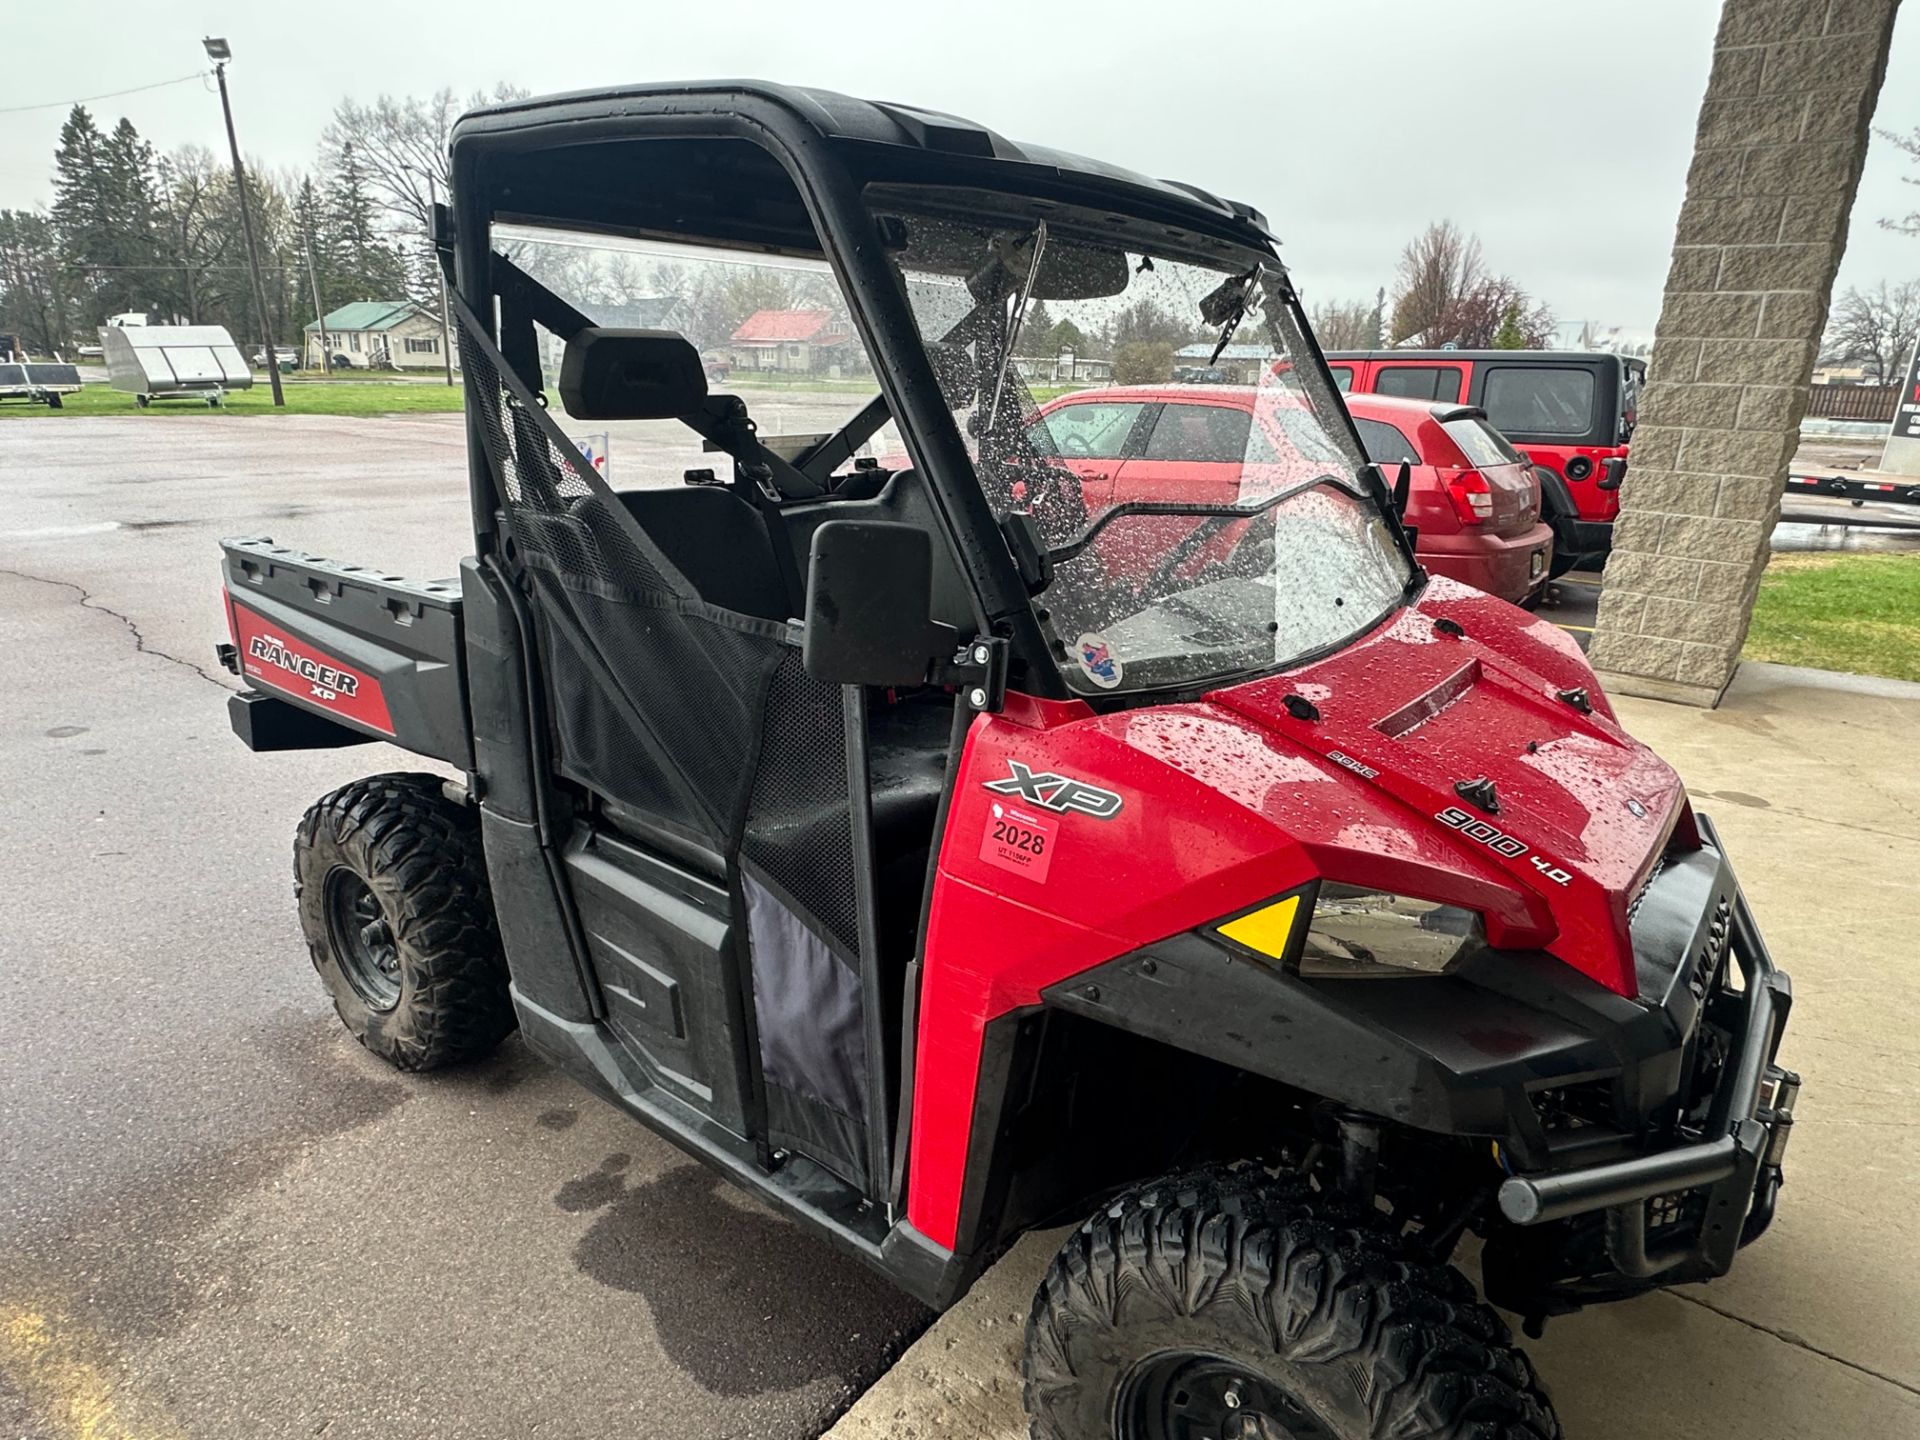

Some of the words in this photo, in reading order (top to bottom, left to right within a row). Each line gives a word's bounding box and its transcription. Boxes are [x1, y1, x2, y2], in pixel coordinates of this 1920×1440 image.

[249, 635, 358, 697] RANGER
[310, 684, 336, 700] XP
[982, 759, 1123, 818] XP
[992, 821, 1045, 855] 2028
[1434, 806, 1529, 858] 900
